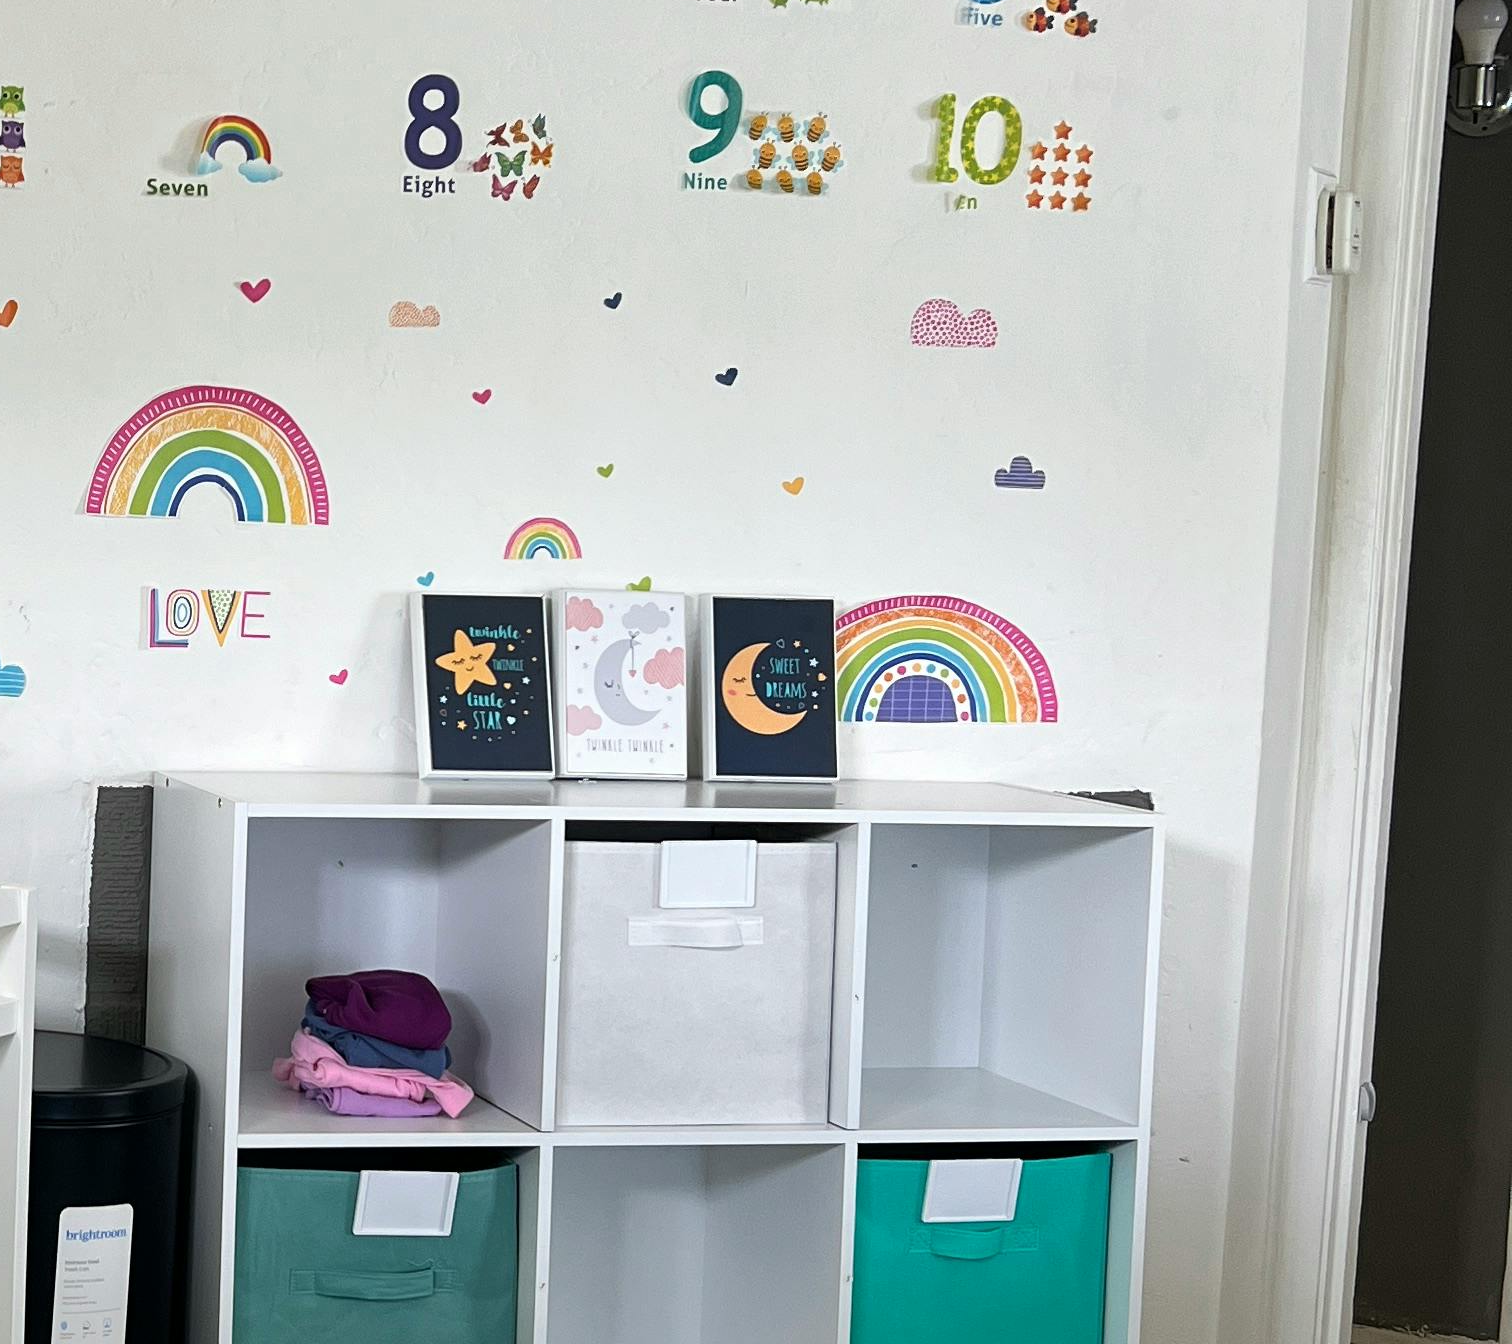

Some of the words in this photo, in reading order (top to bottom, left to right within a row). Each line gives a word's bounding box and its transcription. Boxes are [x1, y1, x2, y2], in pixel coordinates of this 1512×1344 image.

[404, 74, 462, 171] 8
[687, 70, 744, 164] 9
[931, 92, 1023, 186] 10
[147, 179, 209, 197] Seven
[403, 176, 456, 197] Eight
[684, 173, 728, 193] Nine
[150, 588, 271, 647] LOVE
[469, 625, 521, 640] twinkle
[769, 657, 801, 675] SWEET
[766, 682, 807, 699] DREAMS
[467, 692, 506, 709] little
[473, 711, 503, 730] STAR
[586, 738, 624, 753] TWINKLE
[627, 738, 664, 753] TWINKLE
[65, 1228, 127, 1243] brightroom
